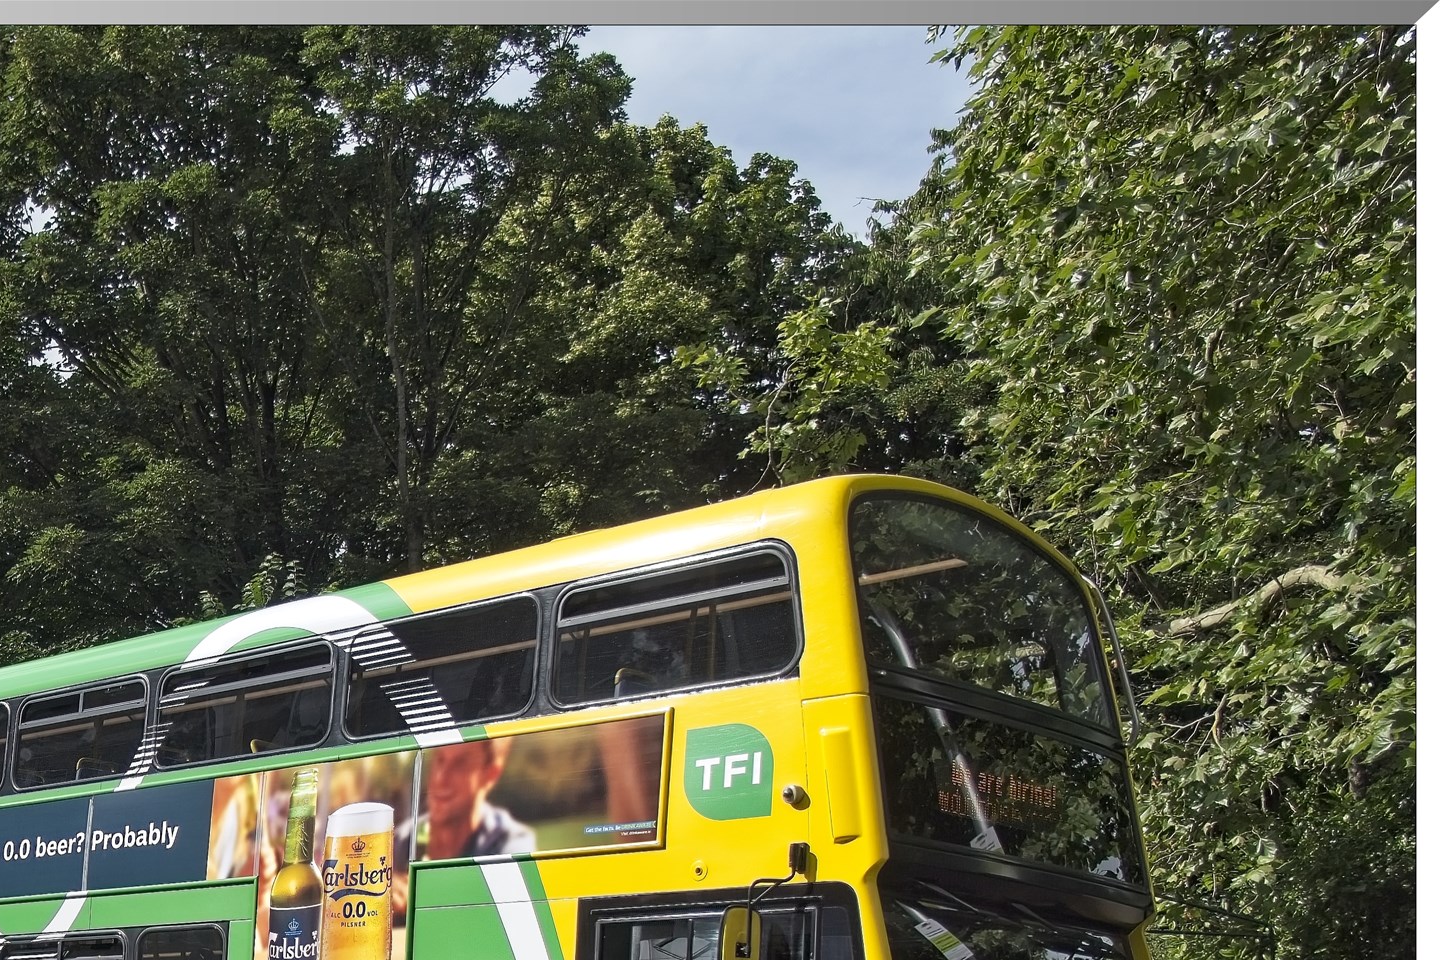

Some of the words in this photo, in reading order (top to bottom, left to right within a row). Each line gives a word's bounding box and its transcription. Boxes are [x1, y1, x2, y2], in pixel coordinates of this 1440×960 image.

[695, 752, 762, 791] TFI
[3, 839, 31, 861] 0.0
[36, 832, 85, 858] beer?
[91, 821, 179, 851] Probably
[322, 857, 393, 893] Carlsberg
[340, 920, 366, 928] PILSNER
[343, 901, 366, 919] 0.0
